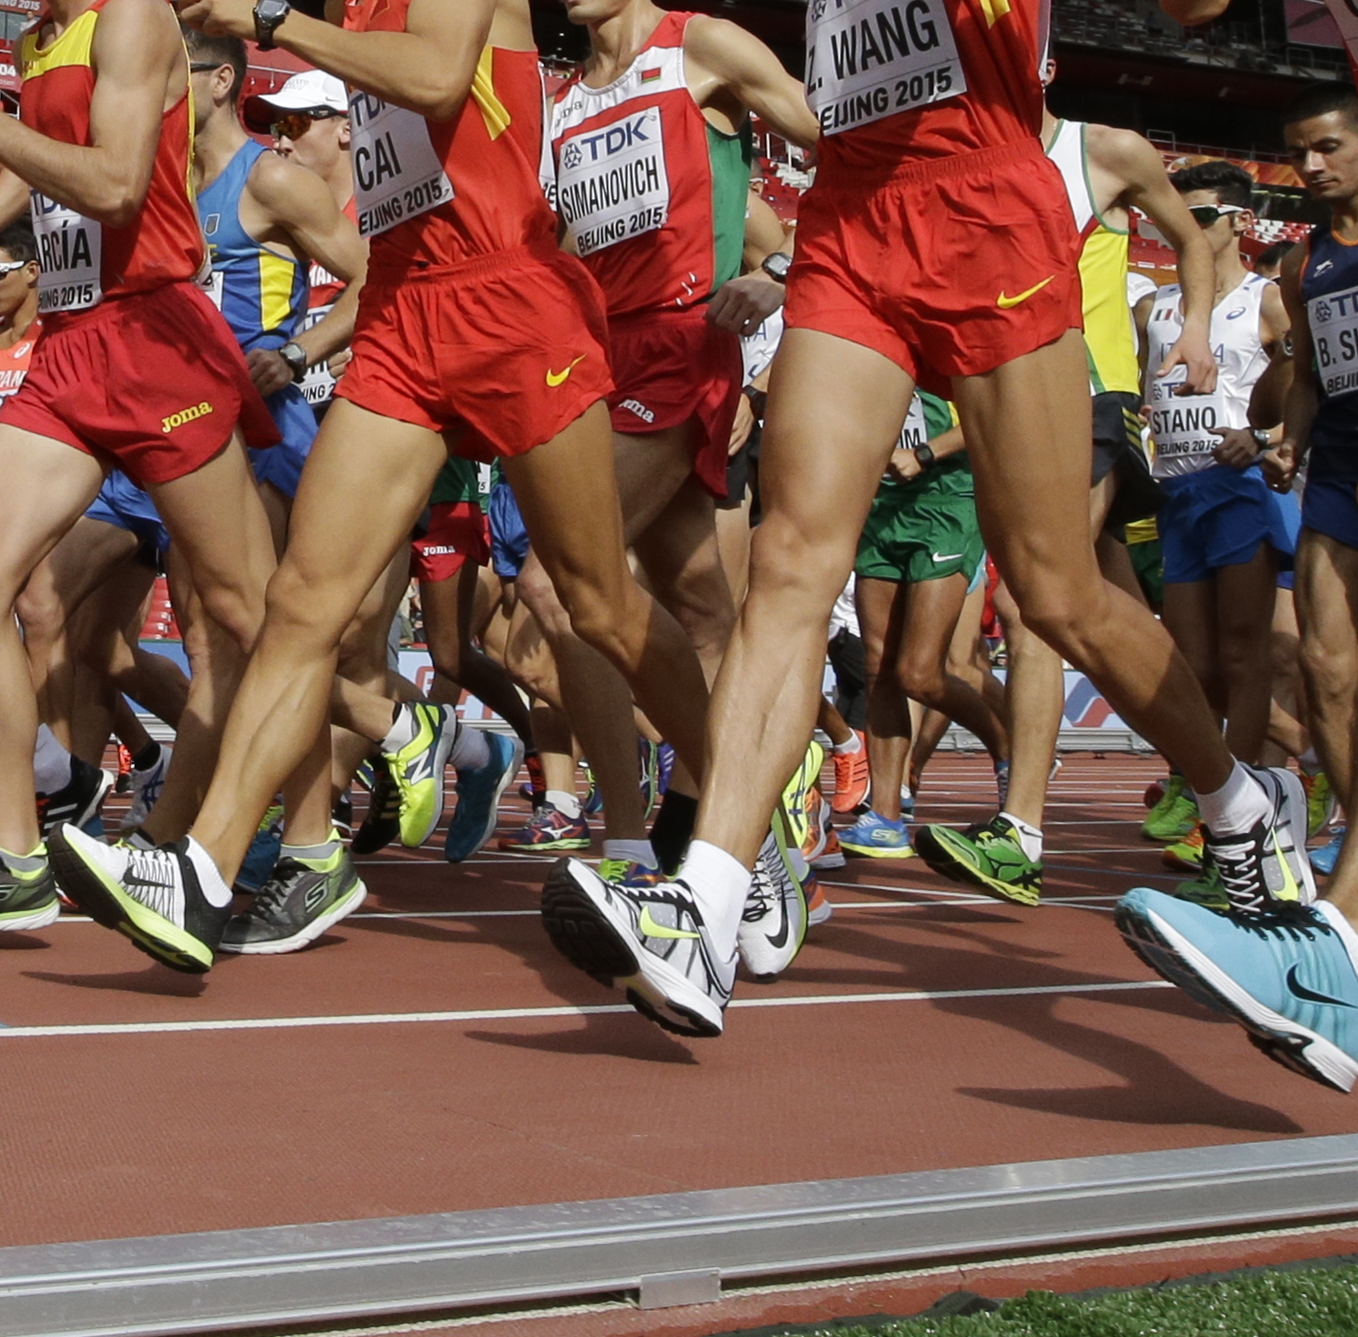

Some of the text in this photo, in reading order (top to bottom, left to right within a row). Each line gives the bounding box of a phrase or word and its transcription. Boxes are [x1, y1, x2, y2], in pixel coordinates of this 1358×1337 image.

[18, 0, 41, 11] 2015
[831, 0, 940, 80] WANG
[820, 66, 953, 132] EIJING 2015
[355, 131, 402, 192] CAI
[581, 117, 649, 161] TDK
[358, 177, 441, 235] EIJING 2015
[561, 155, 660, 224] SIMANOVICH
[35, 220, 93, 274] ARCÍA
[577, 205, 665, 255] BEIJING 2015
[60, 284, 94, 306] 2015
[1317, 337, 1337, 368] B.
[1152, 406, 1217, 435] STANO
[1191, 439, 1219, 452] 2015
